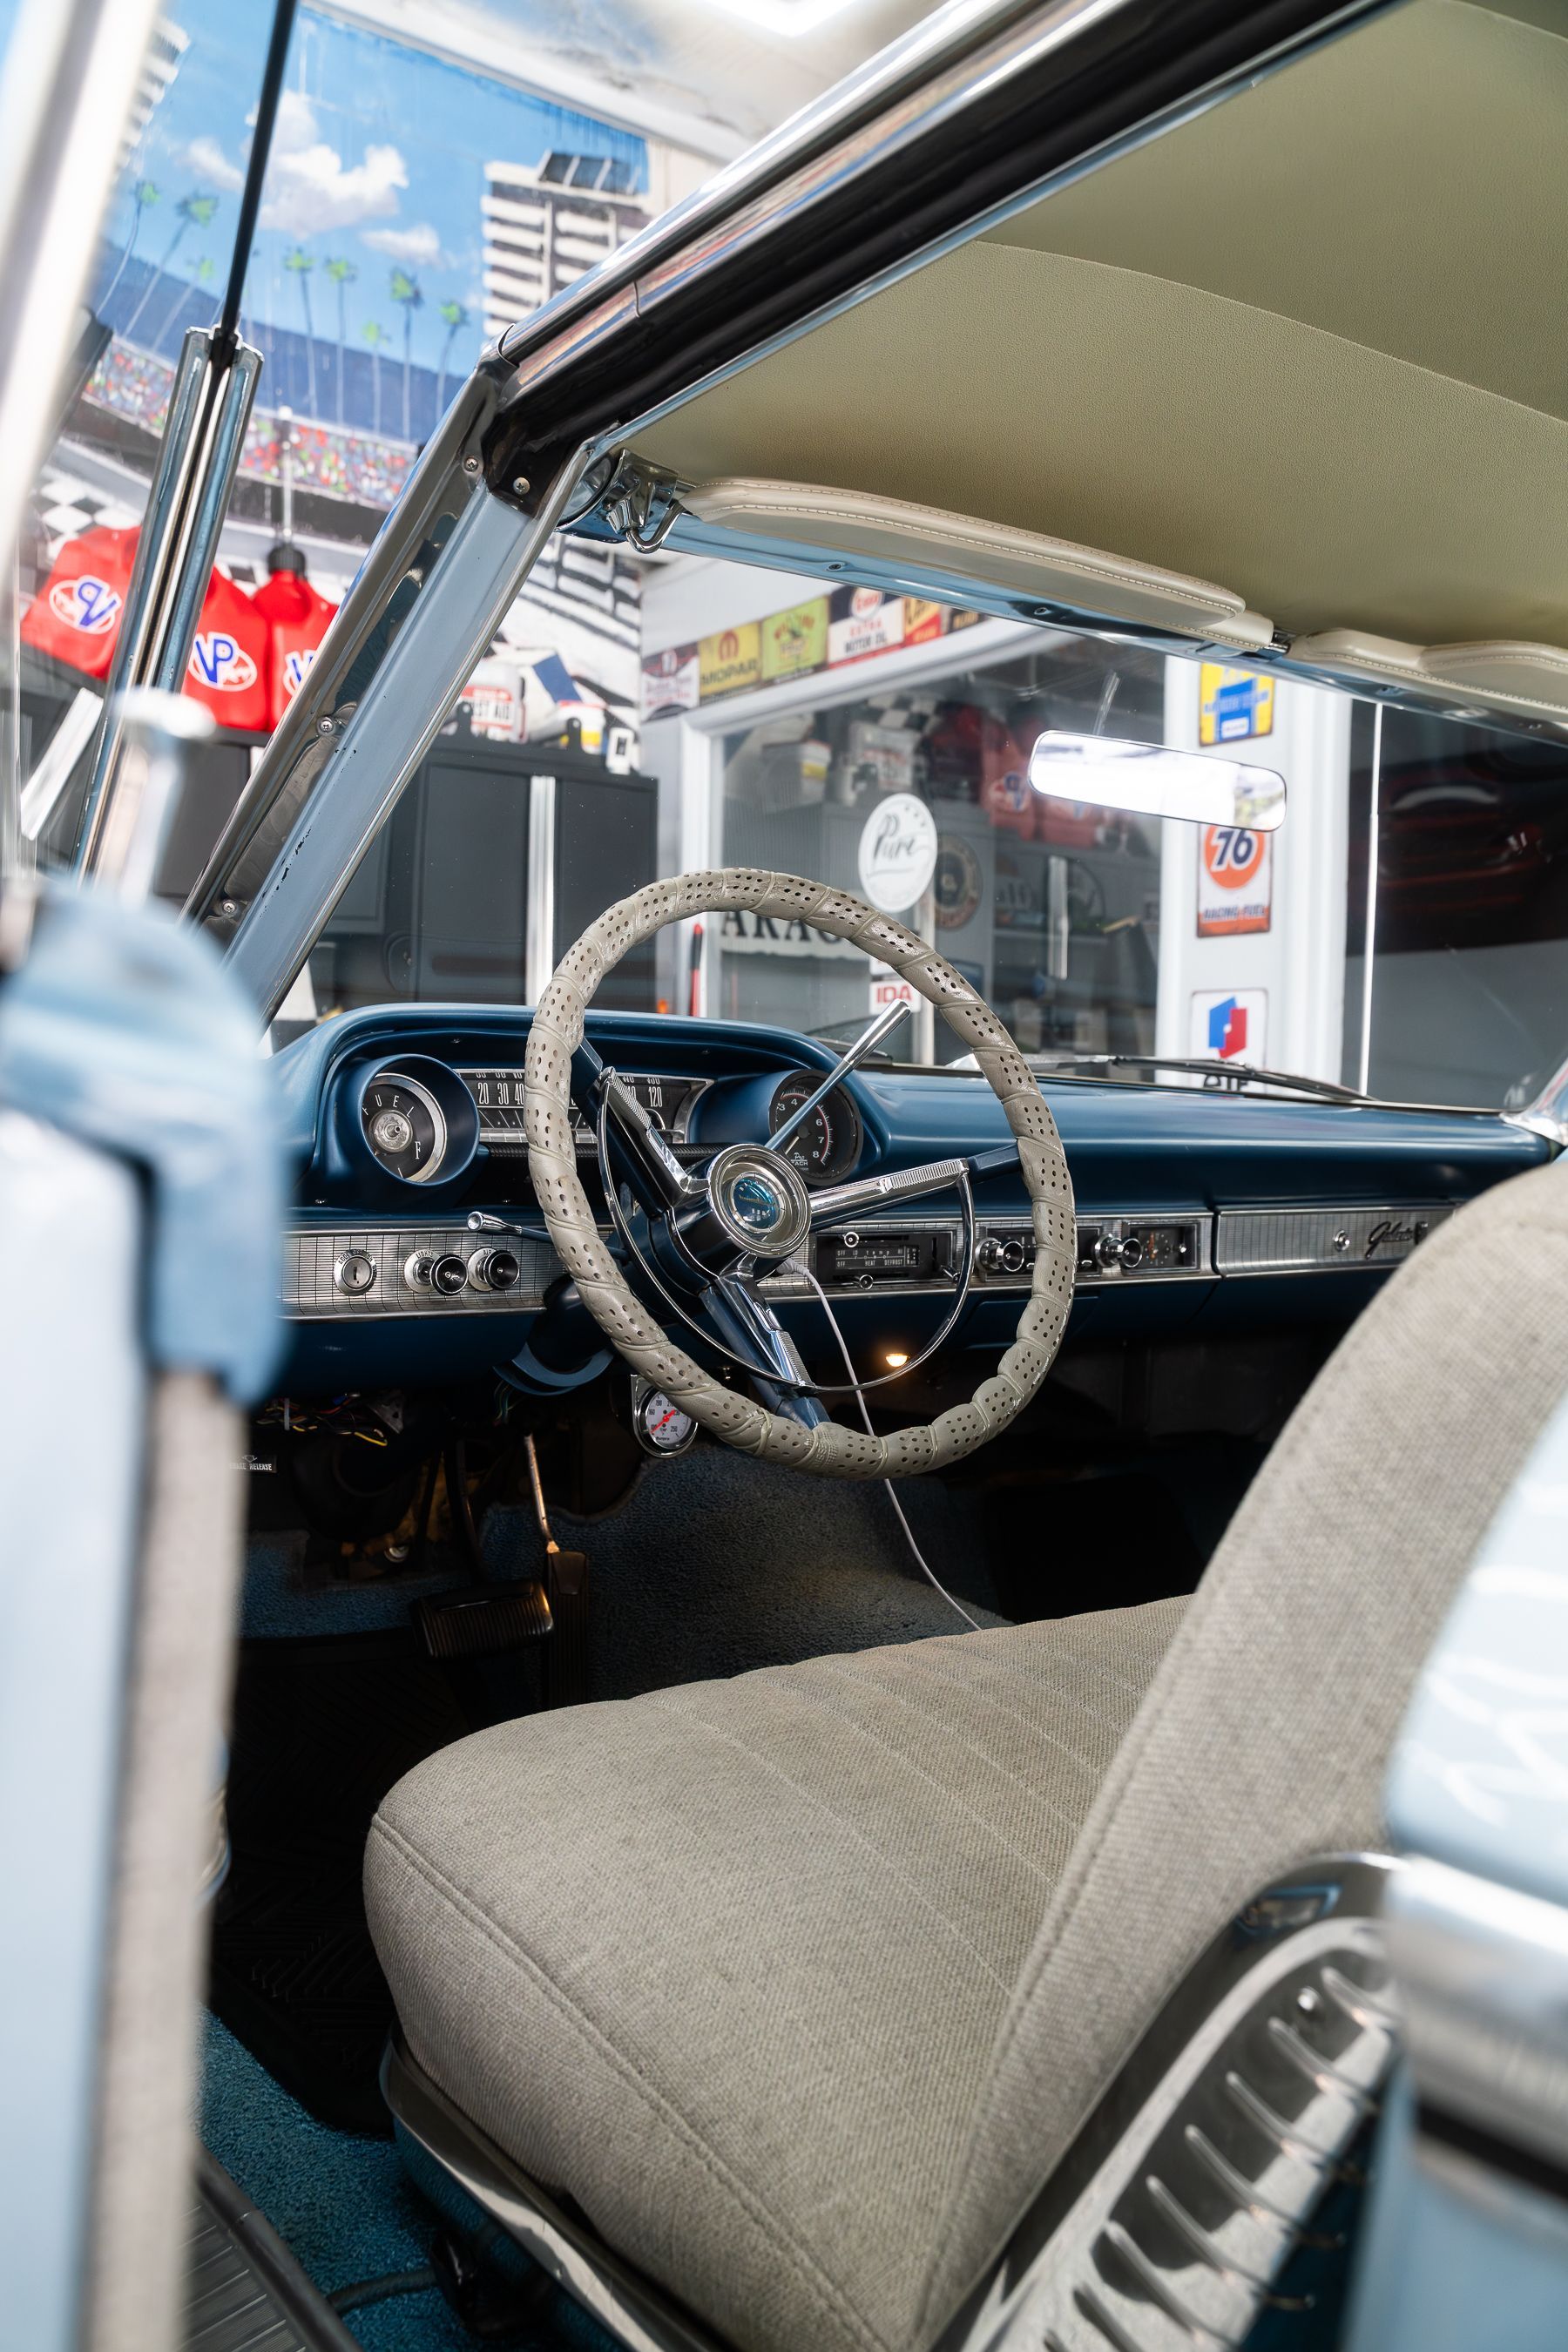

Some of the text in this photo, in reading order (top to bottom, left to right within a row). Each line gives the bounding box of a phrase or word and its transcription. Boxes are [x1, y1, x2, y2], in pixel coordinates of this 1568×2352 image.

[845, 632, 888, 653] MOTOR OIL
[195, 639, 233, 683] VP
[700, 658, 760, 686] MOPAR
[873, 814, 917, 861] Pure
[1216, 829, 1254, 866] 76
[1204, 906, 1240, 920] RACING
[477, 1082, 524, 1105] 20 30 40
[647, 1086, 663, 1108] 120
[790, 1098, 798, 1106] 4
[779, 1103, 786, 1112] 3
[414, 1140, 422, 1160] F
[812, 1150, 820, 1159] 8
[416, 1250, 434, 1259] LIGHTS
[249, 1463, 273, 1471] RELEASE
